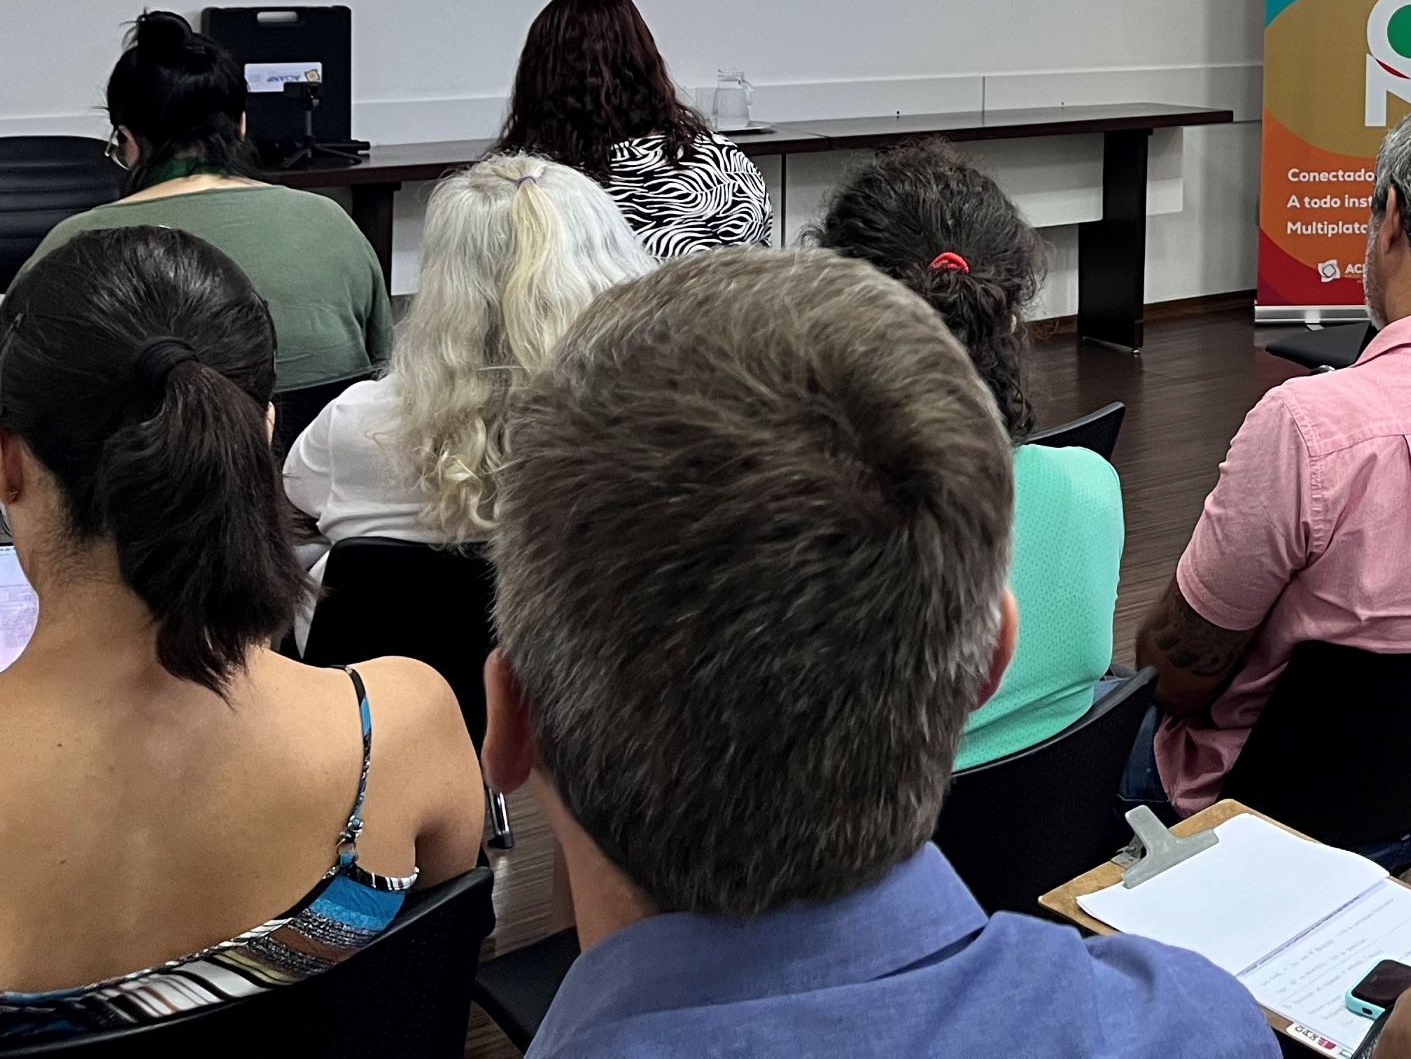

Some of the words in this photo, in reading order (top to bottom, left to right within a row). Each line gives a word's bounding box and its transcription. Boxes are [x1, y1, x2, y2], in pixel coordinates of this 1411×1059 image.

[1286, 194, 1300, 208] A
[1303, 194, 1341, 208] todo
[1344, 194, 1373, 208] inst
